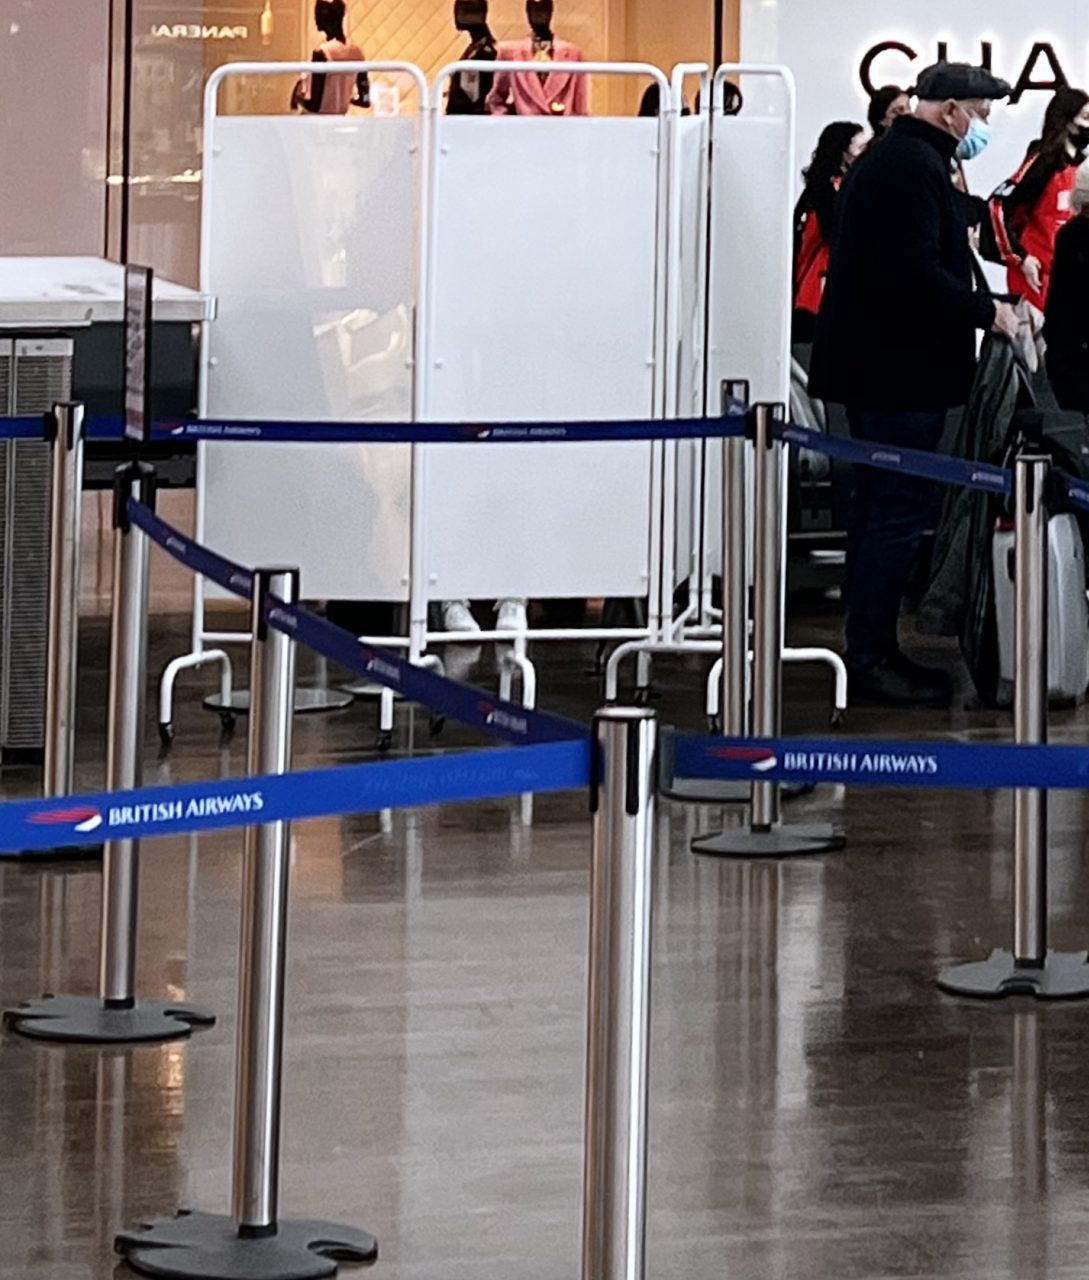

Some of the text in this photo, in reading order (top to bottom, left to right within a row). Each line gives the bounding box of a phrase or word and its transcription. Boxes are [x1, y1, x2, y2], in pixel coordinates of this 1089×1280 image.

[783, 752, 938, 773] BRITISH AIRWAYS
[109, 792, 264, 826] BRITISH AIRWAYS
